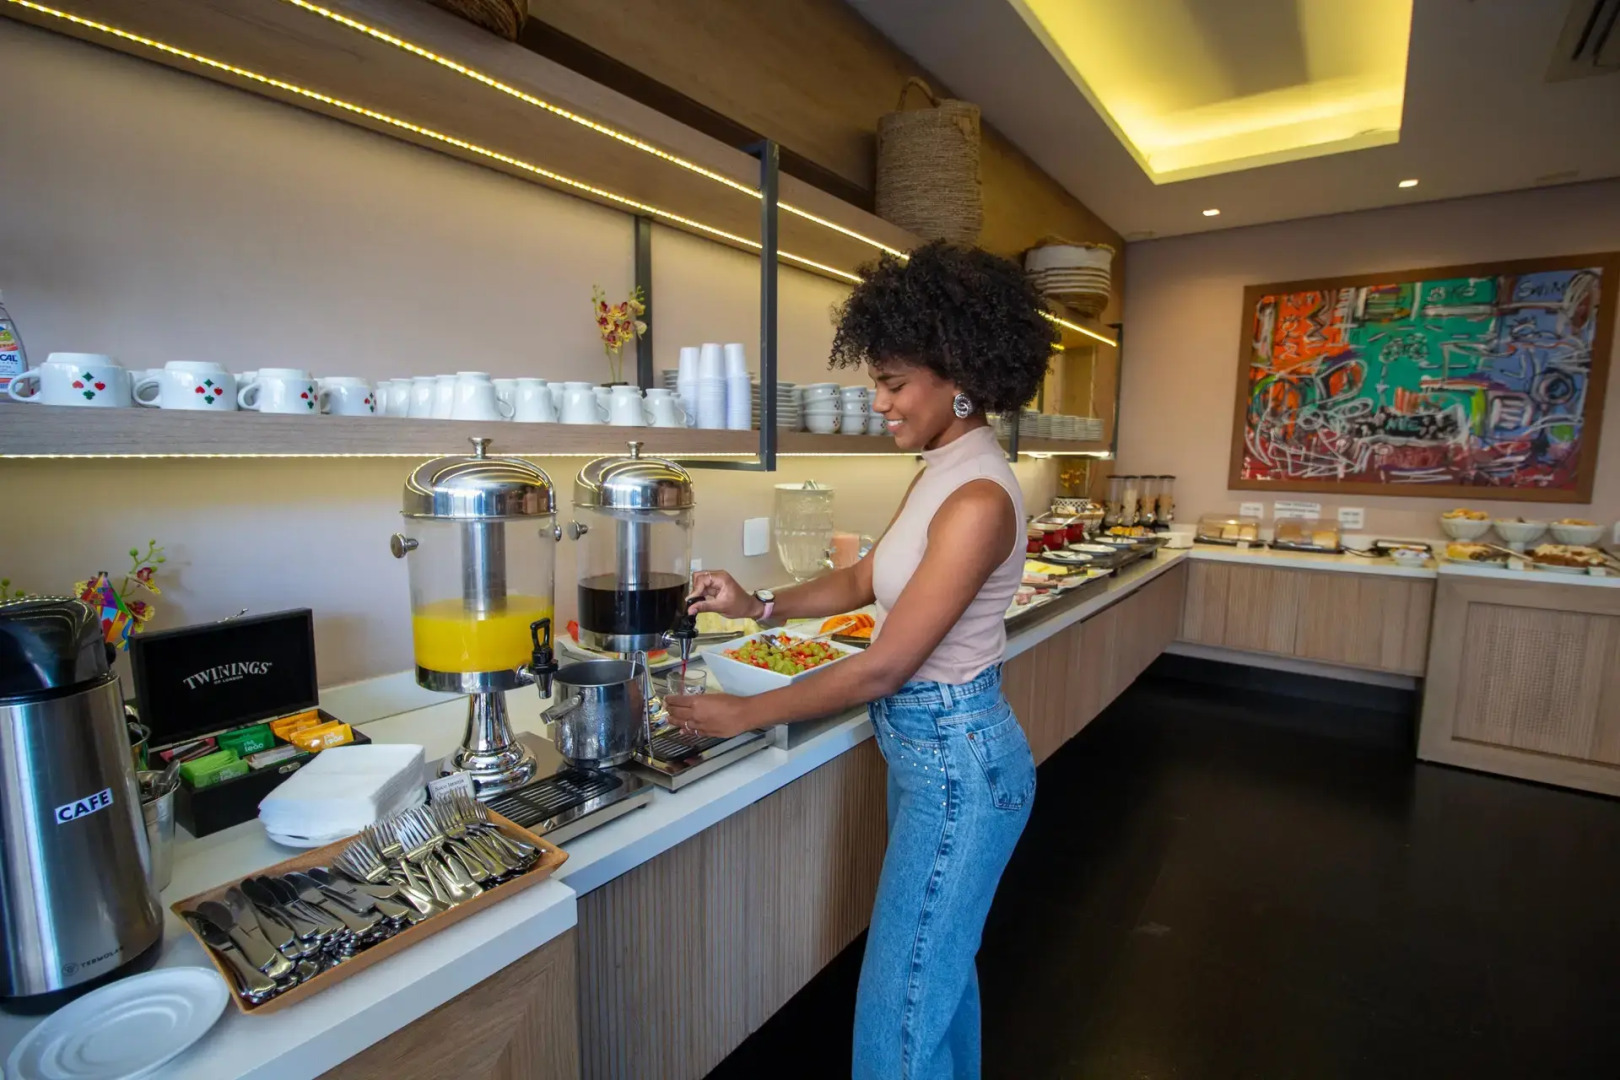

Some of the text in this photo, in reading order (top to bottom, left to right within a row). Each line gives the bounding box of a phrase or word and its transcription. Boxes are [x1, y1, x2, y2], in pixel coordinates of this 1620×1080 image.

[183, 661, 270, 690] TWININGS
[222, 675, 243, 683] LONDON
[58, 791, 109, 821] CAFE
